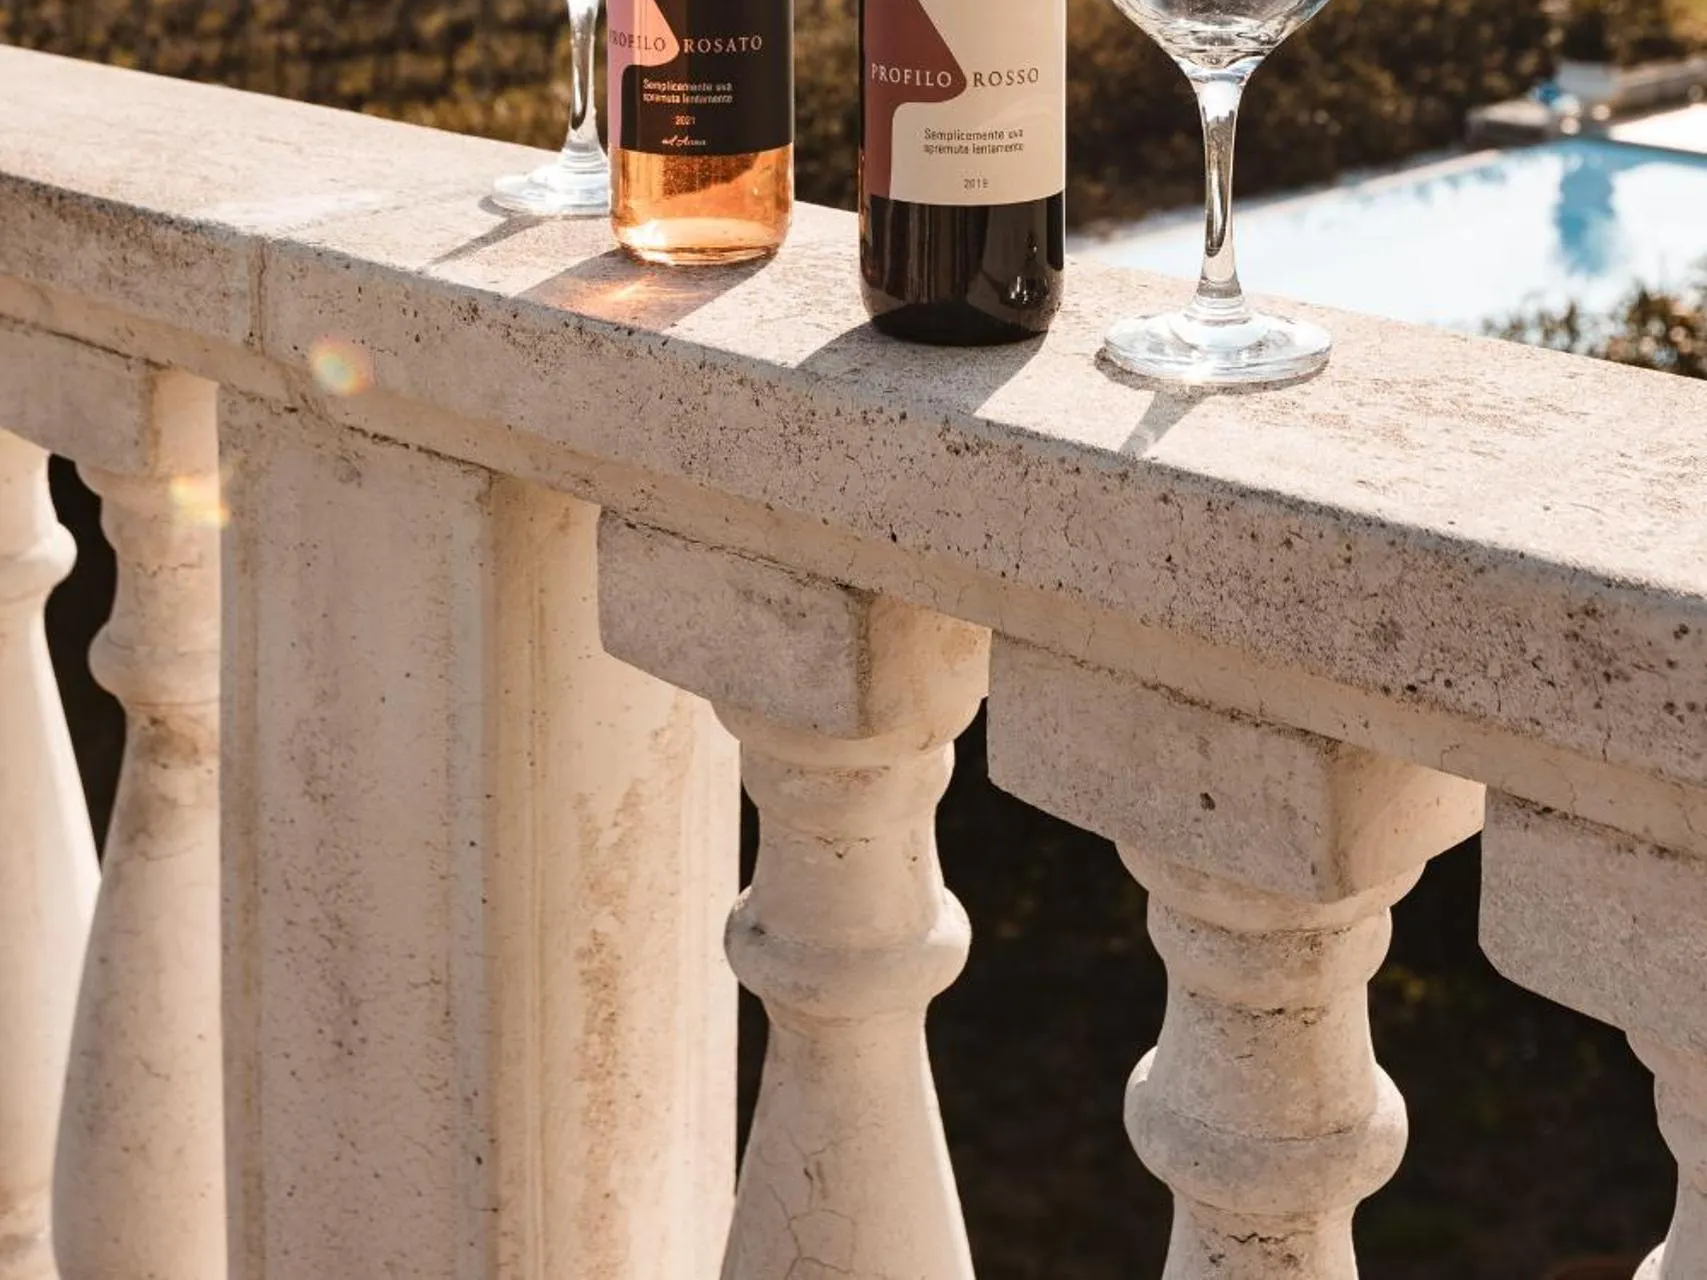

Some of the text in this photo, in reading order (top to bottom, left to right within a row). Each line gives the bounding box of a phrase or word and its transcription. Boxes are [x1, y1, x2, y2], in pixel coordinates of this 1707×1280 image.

[683, 35, 763, 54] ROSATO
[871, 63, 1039, 88] PROFILO ROSSO
